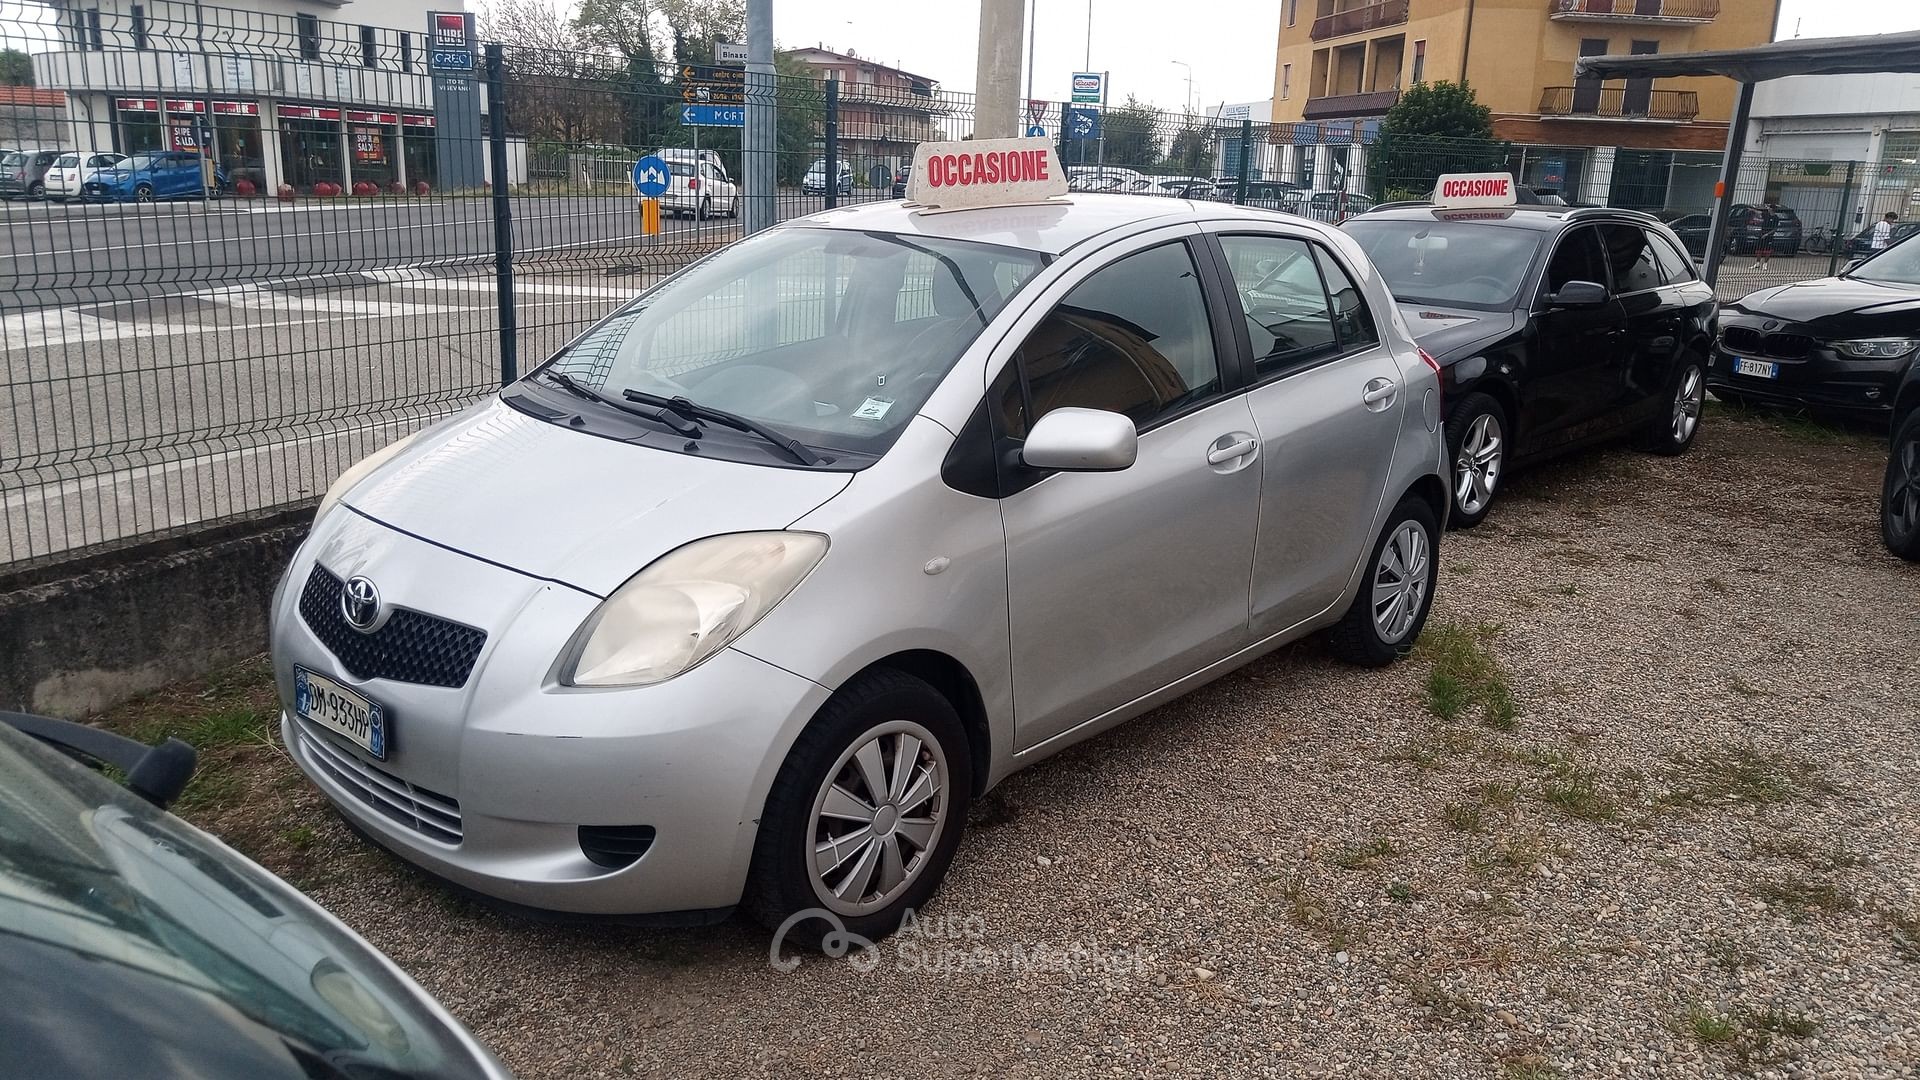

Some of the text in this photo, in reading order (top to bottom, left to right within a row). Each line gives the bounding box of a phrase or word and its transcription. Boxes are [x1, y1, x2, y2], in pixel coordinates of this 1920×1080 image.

[438, 29, 463, 43] LUBE
[722, 51, 747, 59] Binasc
[714, 110, 744, 121] MORT
[174, 127, 191, 136] SUPE
[928, 150, 1049, 188] OCCASIONE
[1443, 180, 1508, 197] OCCASIONE
